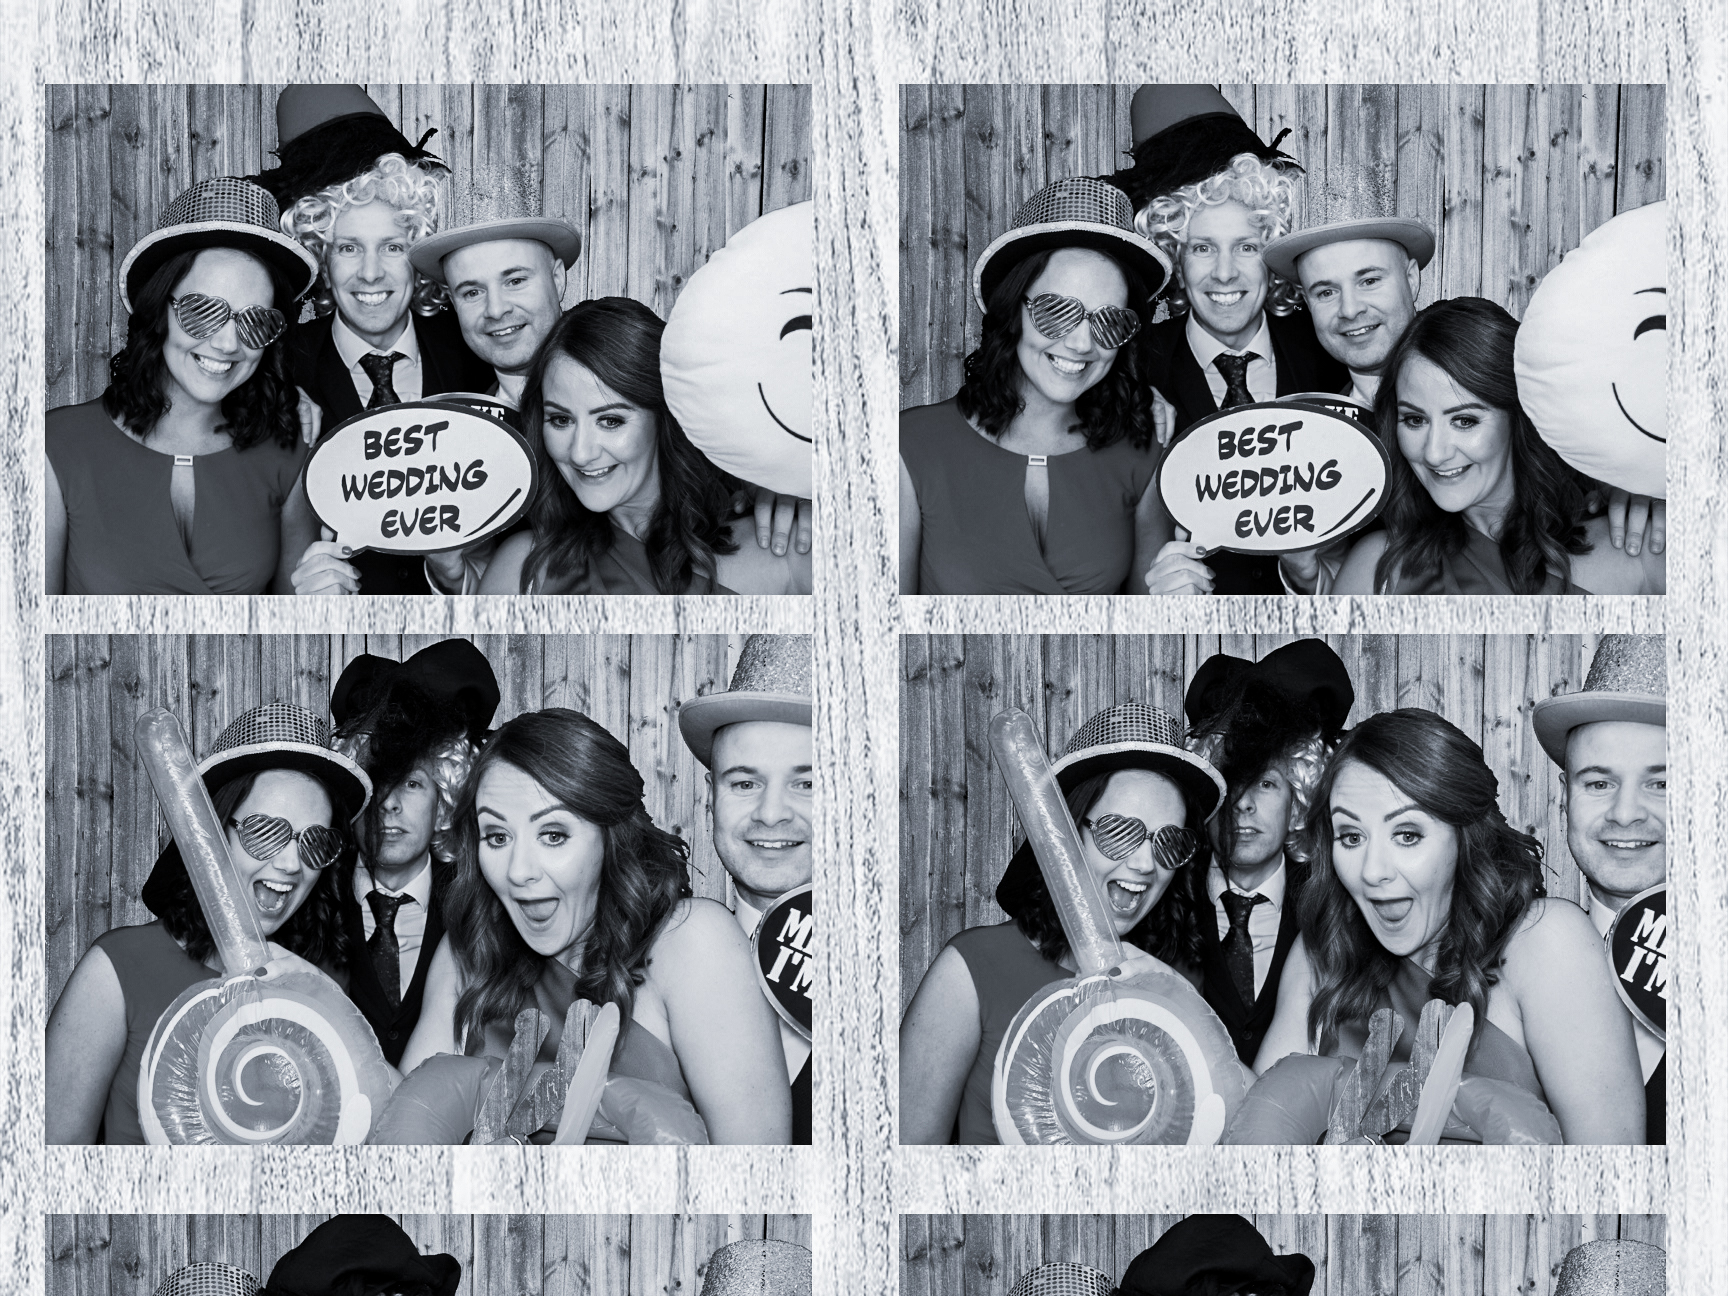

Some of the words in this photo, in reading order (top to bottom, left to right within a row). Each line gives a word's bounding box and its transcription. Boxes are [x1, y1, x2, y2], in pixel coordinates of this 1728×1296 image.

[364, 420, 449, 460] BEST
[1218, 420, 1303, 460] BEST
[341, 459, 488, 502] WEDDING
[1195, 459, 1342, 502] WEDDING
[380, 504, 461, 538] EVER
[1234, 504, 1315, 538] EVER
